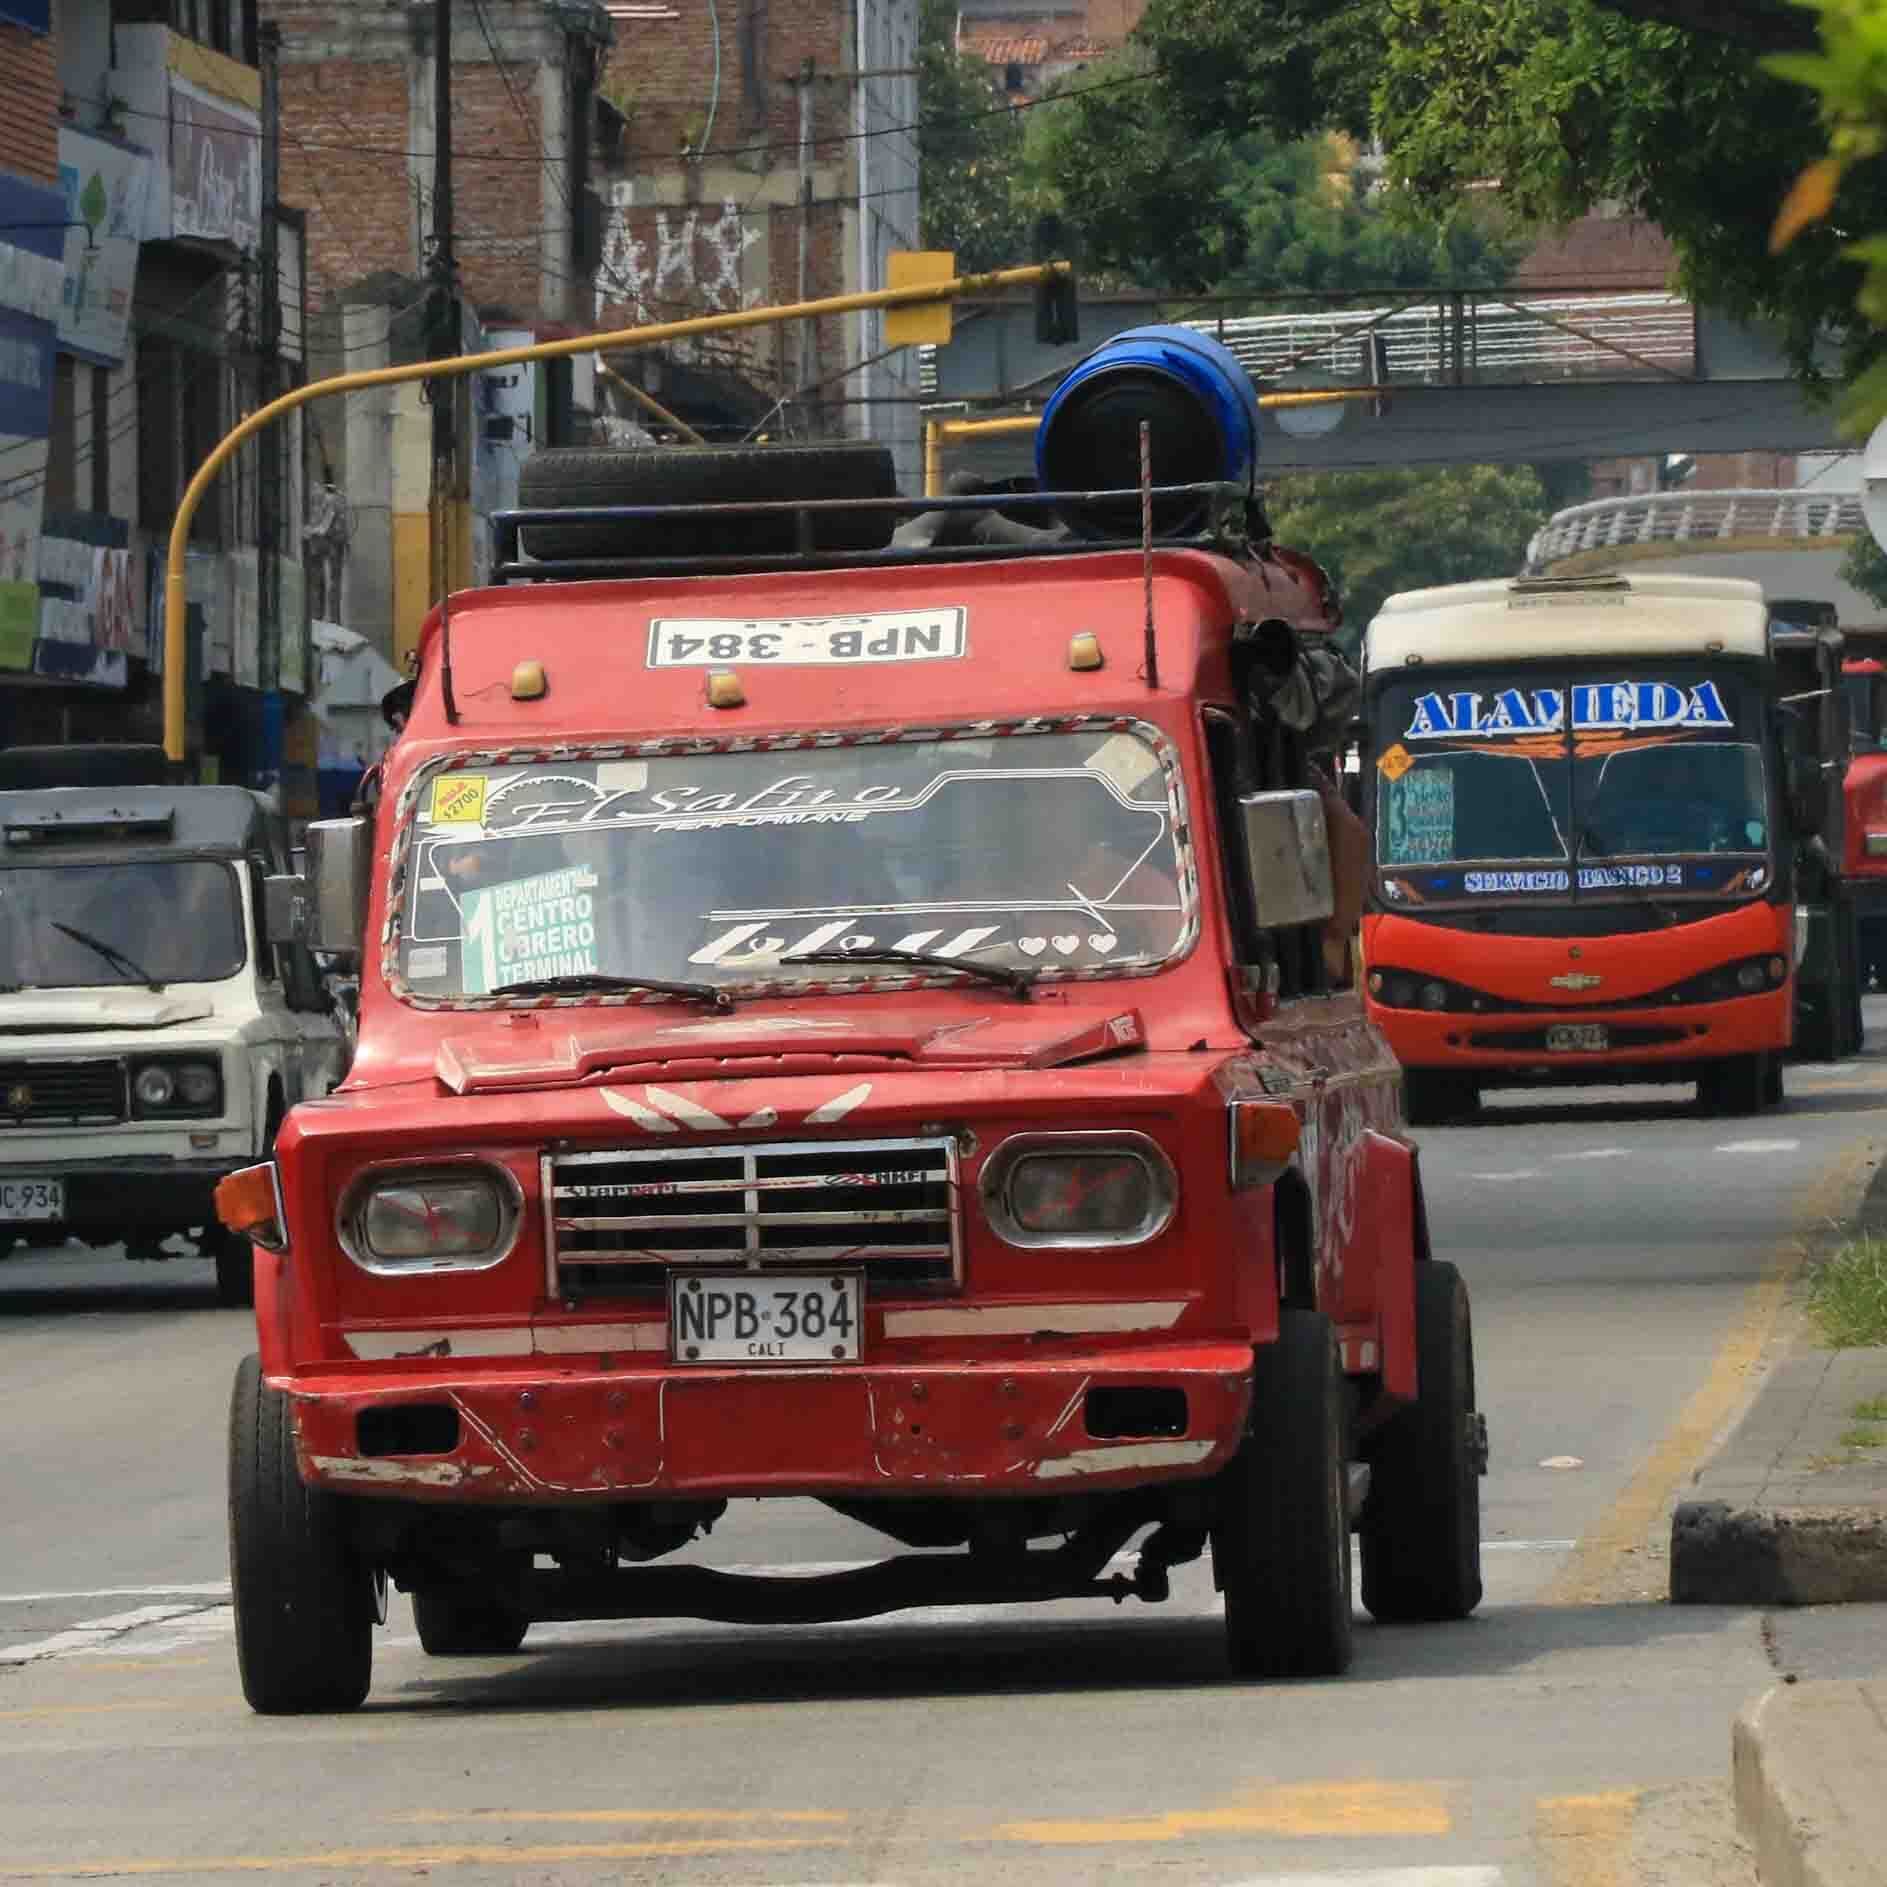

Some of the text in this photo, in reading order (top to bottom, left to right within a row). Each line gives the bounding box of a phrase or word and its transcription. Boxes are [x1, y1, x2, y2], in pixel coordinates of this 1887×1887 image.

[497, 894, 592, 934] CENTRO
[464, 889, 497, 992] 1
[500, 949, 599, 986] TERMINAL
[748, 1342, 785, 1356] CALI
